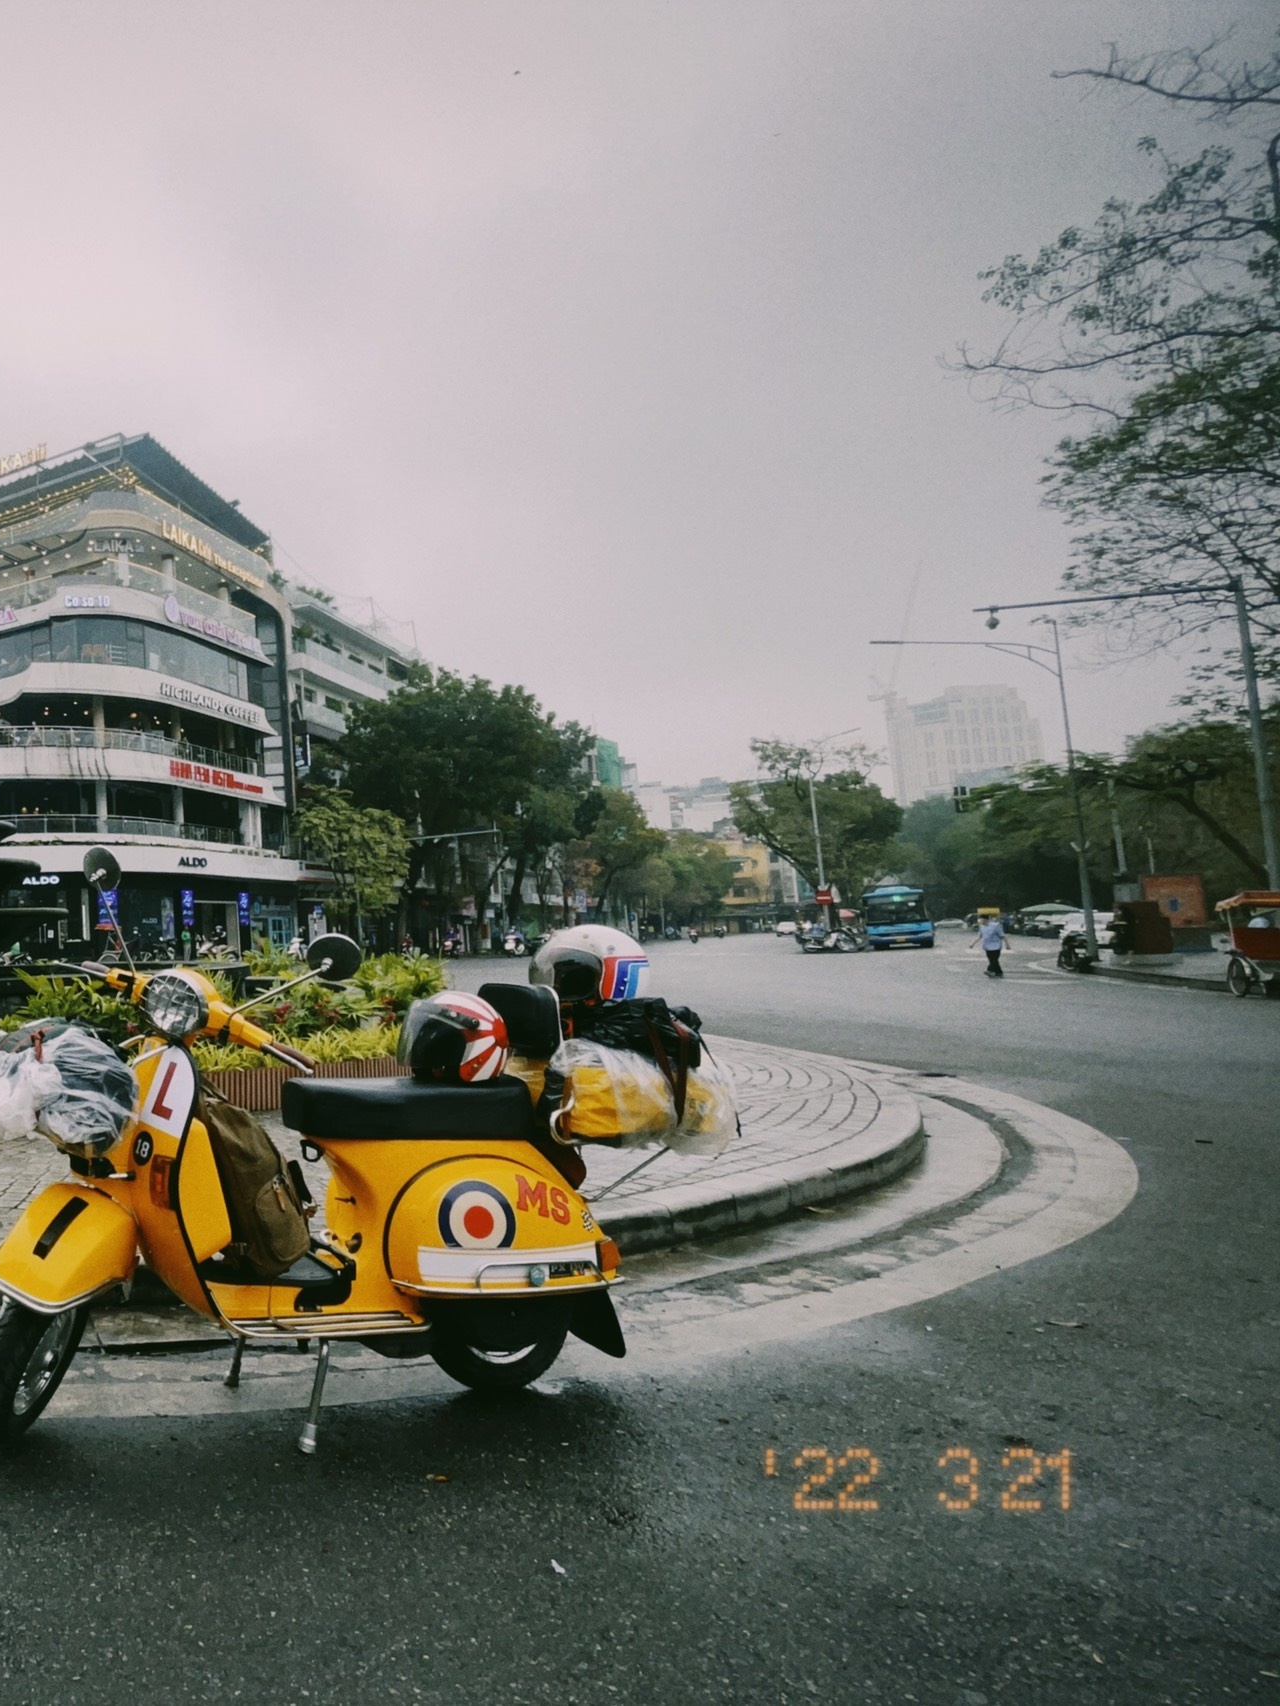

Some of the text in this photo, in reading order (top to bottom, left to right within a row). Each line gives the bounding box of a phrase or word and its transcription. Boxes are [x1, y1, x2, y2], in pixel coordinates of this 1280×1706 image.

[98, 595, 110, 608] 10
[161, 683, 261, 722] HIGHLANDS COFFEE
[178, 856, 207, 868] ALDO
[22, 875, 61, 885] ALDO
[151, 1061, 177, 1121] L
[135, 1138, 150, 1158] 18
[515, 1174, 571, 1226] MS
